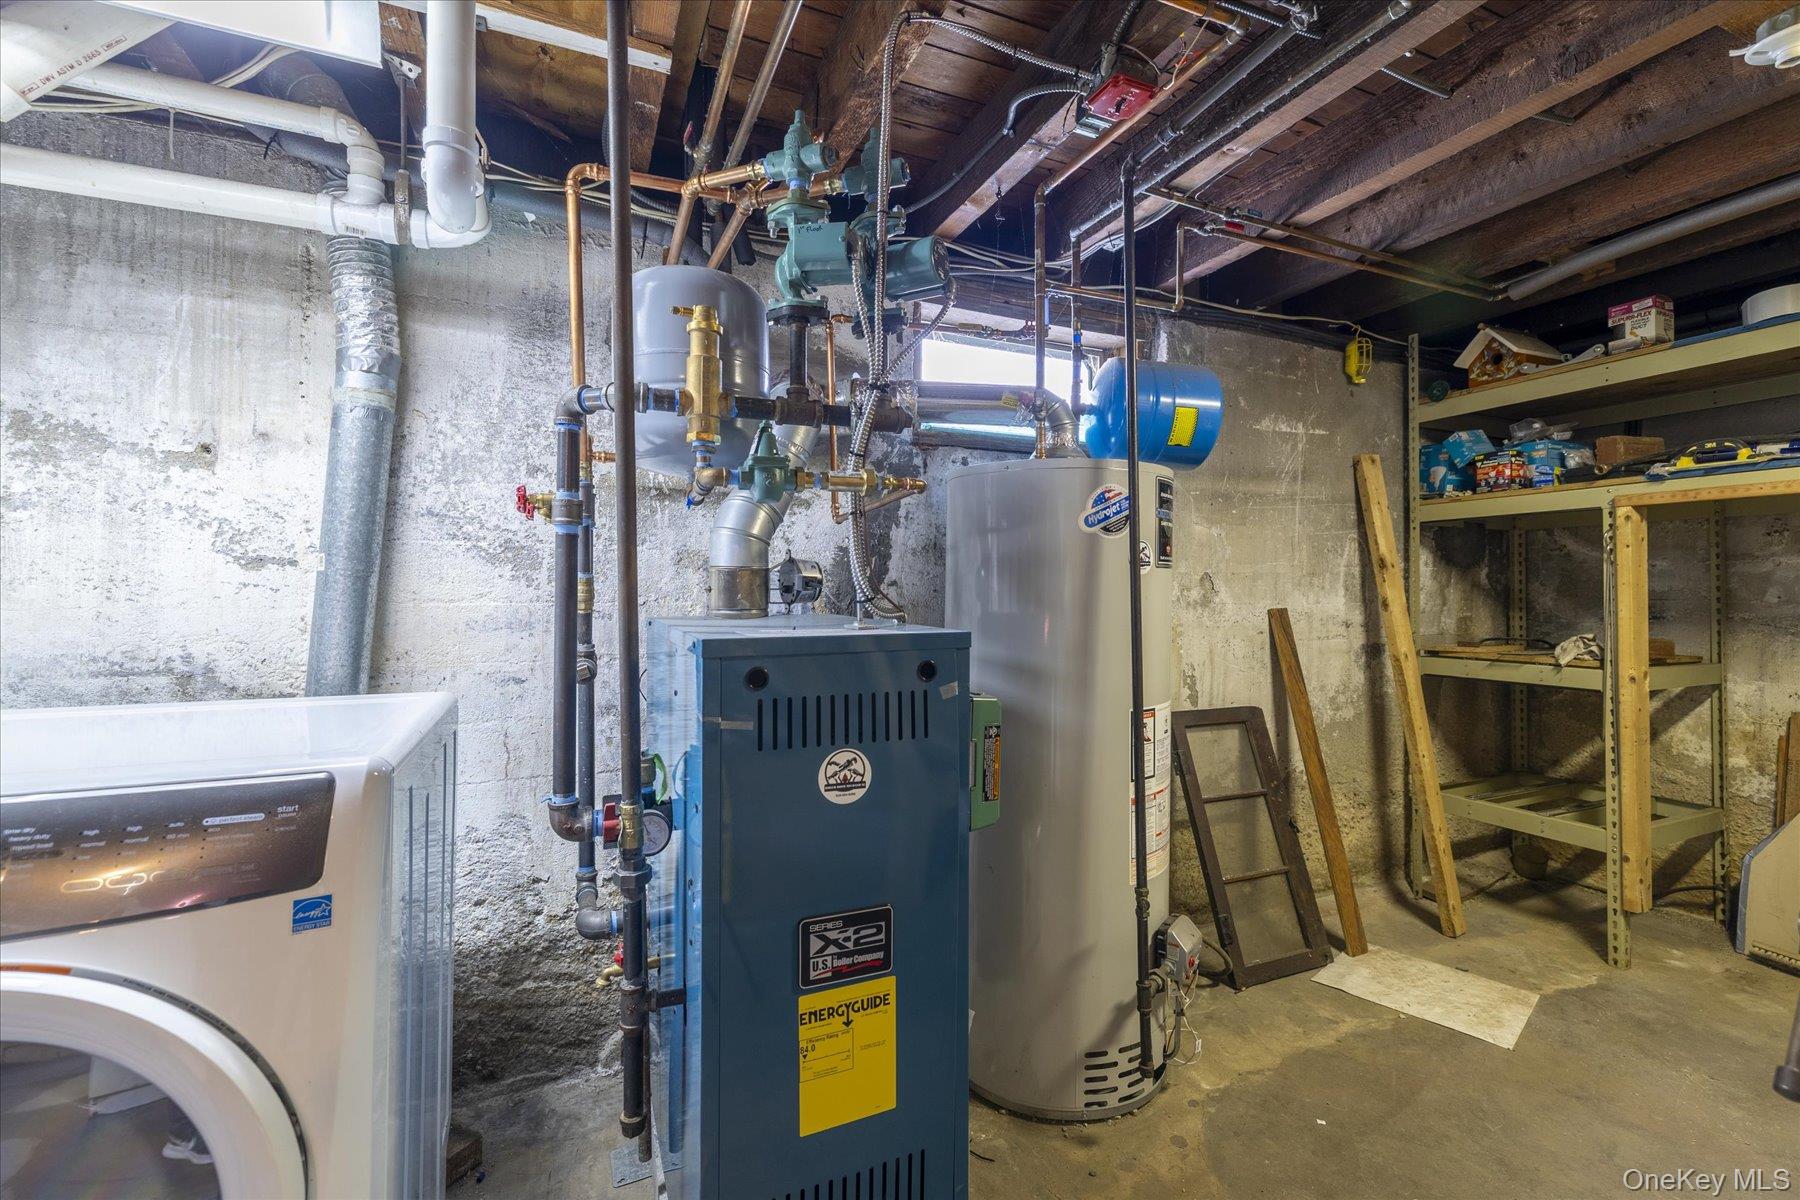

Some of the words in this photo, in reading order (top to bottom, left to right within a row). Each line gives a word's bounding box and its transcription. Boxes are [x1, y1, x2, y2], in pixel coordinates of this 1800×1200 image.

[56, 63, 75, 77] ASTM
[1087, 502, 1121, 526] Hydrojet
[277, 804, 299, 813] start
[293, 923, 316, 932] ENERGY
[316, 920, 331, 928] STAR
[809, 920, 843, 932] SERIES
[811, 958, 832, 972] U.S.
[833, 956, 854, 968] Boiler
[853, 951, 884, 963] Company
[799, 993, 891, 1027] ENERGYGUIDE
